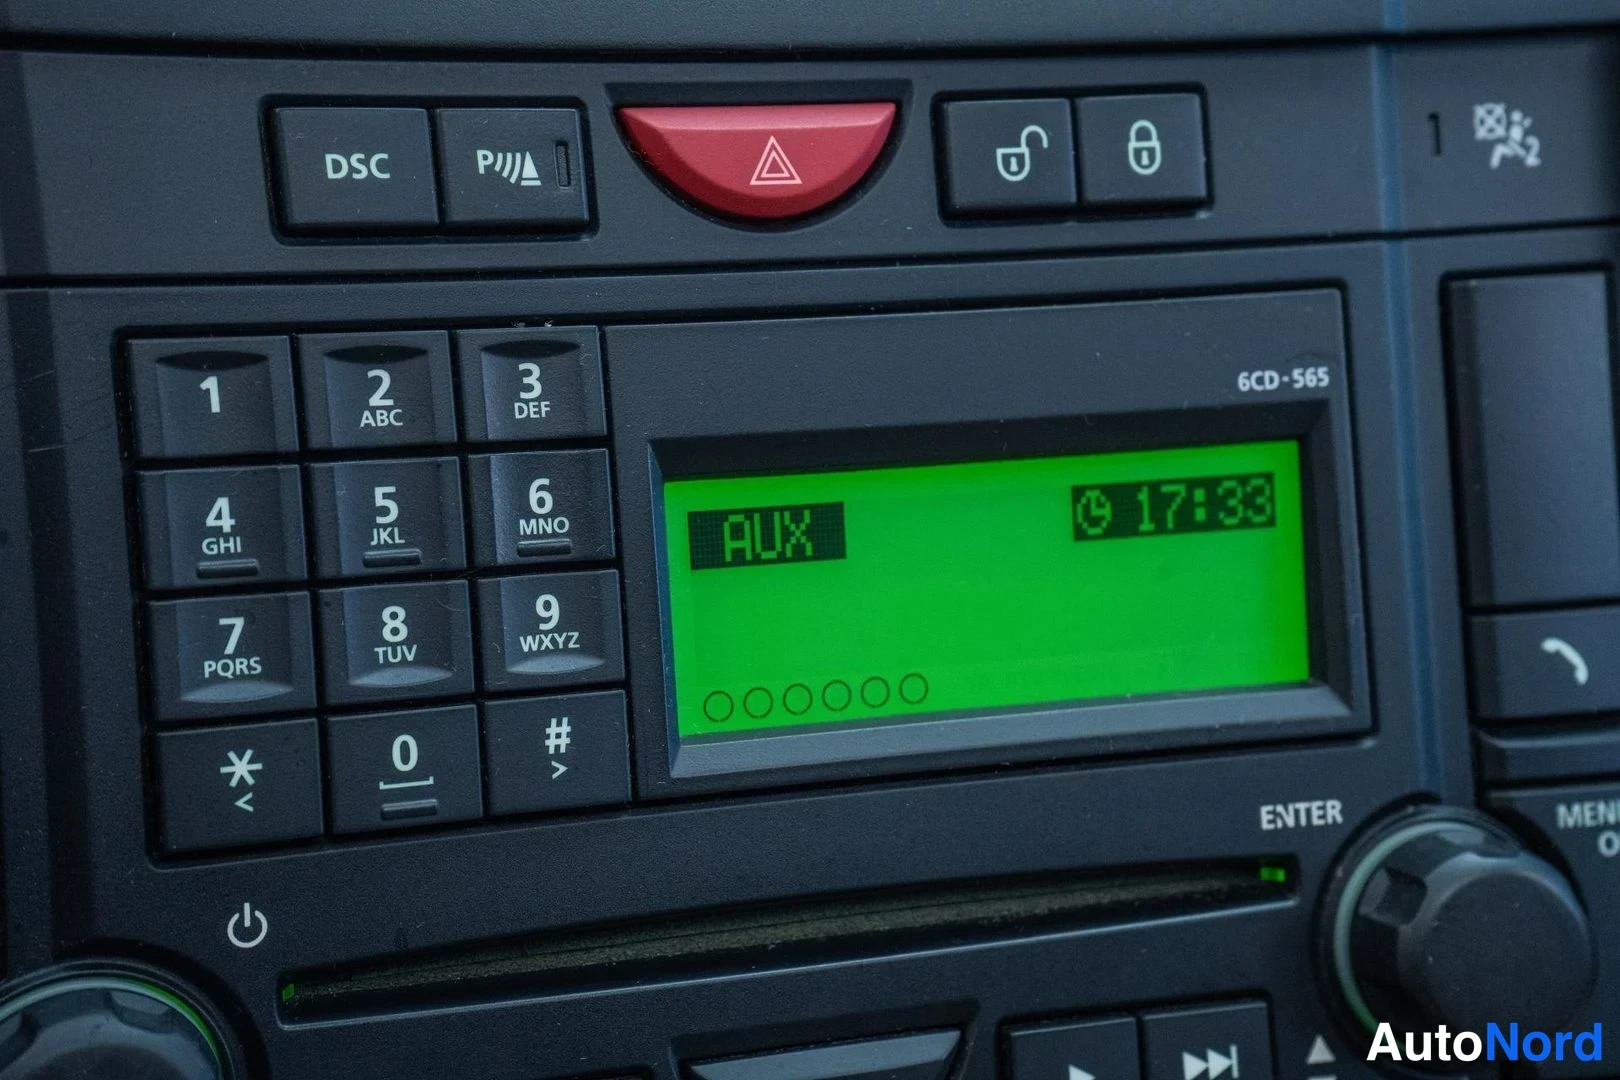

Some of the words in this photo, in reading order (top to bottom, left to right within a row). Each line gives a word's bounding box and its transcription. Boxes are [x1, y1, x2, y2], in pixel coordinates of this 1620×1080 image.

[325, 153, 390, 179] DSC
[200, 376, 220, 412] 1
[368, 370, 394, 406] 2
[519, 363, 541, 399] 3
[360, 409, 403, 427] ABC
[515, 402, 550, 419] DEF
[375, 486, 398, 523] 5
[529, 478, 553, 514] 6
[1136, 478, 1272, 532] 17:33
[206, 497, 235, 532] 4
[520, 517, 569, 535] MNO
[202, 537, 241, 554] GHI
[371, 527, 405, 545] JKL
[723, 511, 812, 563] AUX
[382, 606, 407, 642] 8
[536, 594, 559, 630] 9
[219, 617, 244, 654] 7
[520, 631, 579, 652] WXYZ
[204, 657, 261, 678] PQRS
[374, 645, 417, 663] TUV
[392, 735, 418, 771] 0
[1261, 800, 1343, 830] ENTER
[1558, 800, 1620, 827] MEN
